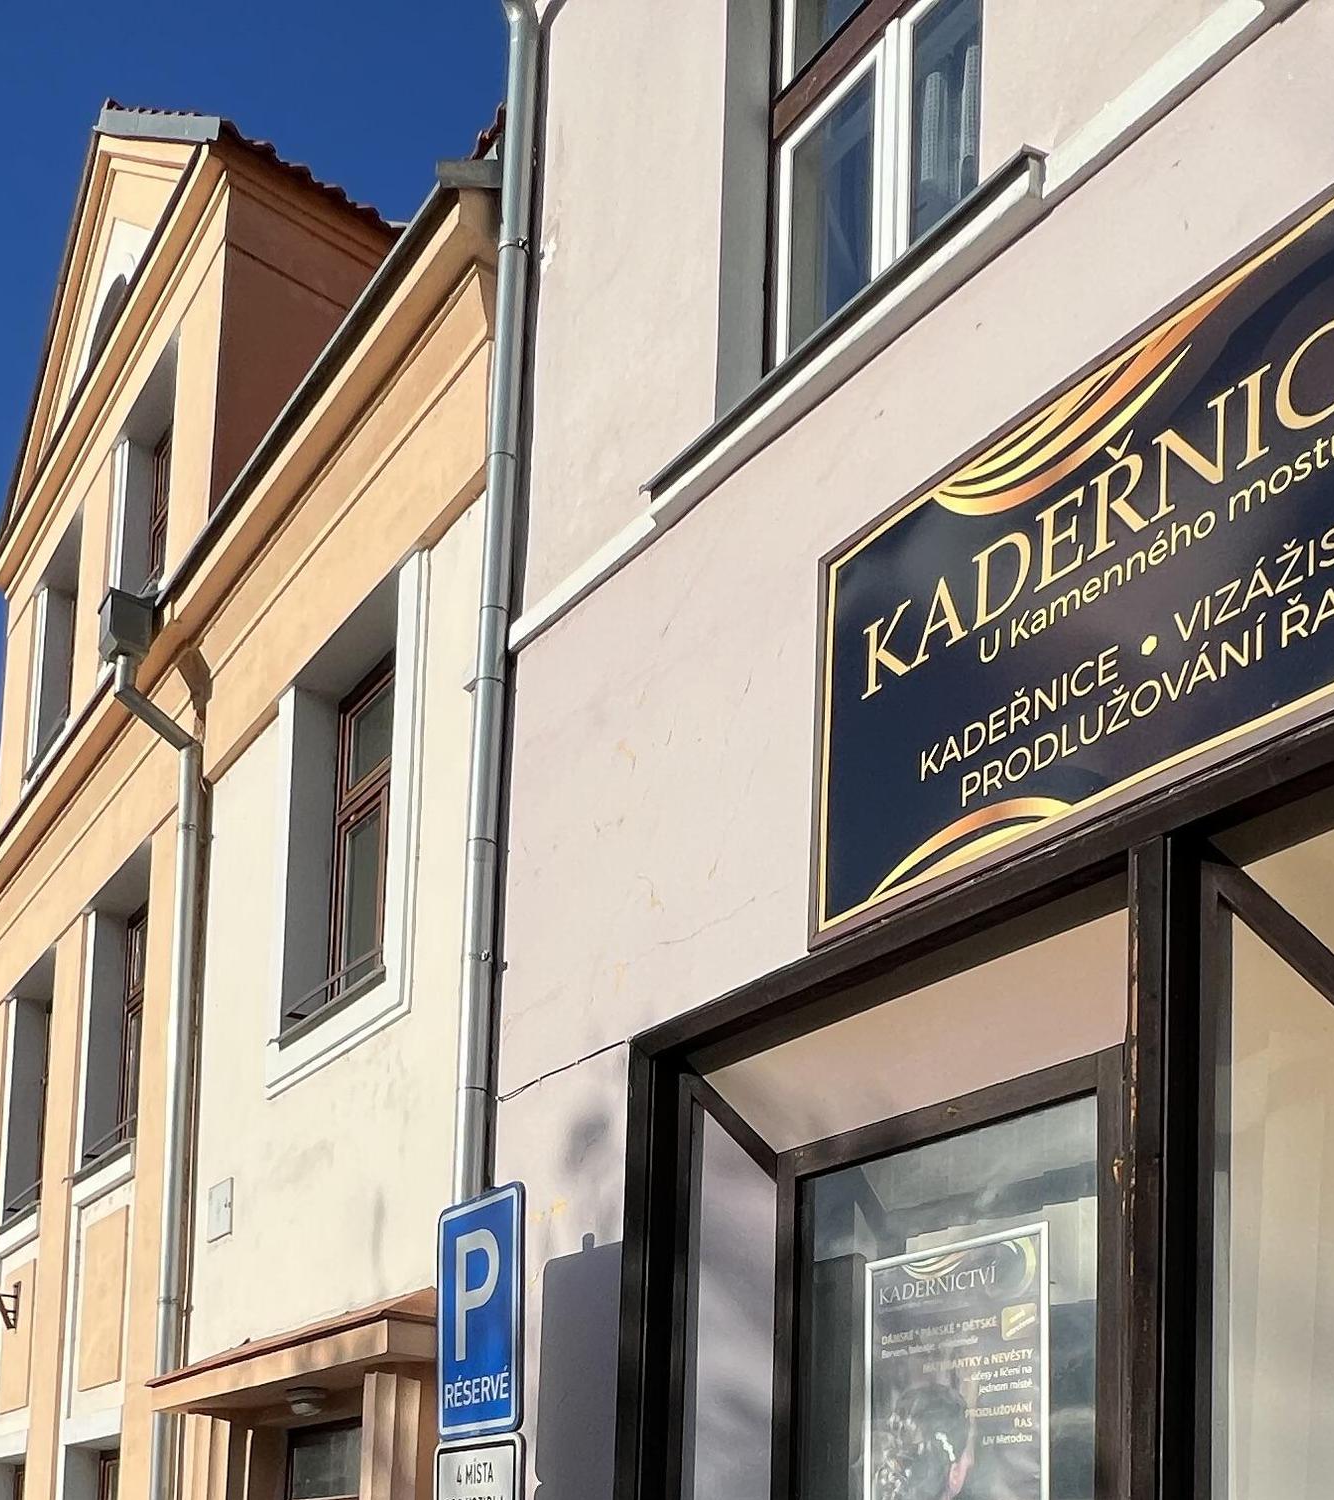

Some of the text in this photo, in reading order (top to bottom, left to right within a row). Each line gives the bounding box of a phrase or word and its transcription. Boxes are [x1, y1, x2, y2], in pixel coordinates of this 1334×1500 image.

[978, 634, 1002, 664] U
[1009, 508, 1217, 658] Kamenného
[919, 644, 1121, 782] KADEŘNICE
[960, 621, 1266, 807] PRODLUŽOVÁNÍ
[455, 1227, 500, 1361] P
[444, 1367, 510, 1410] RÉSERVÉ
[465, 1456, 495, 1485] MÍSTA
